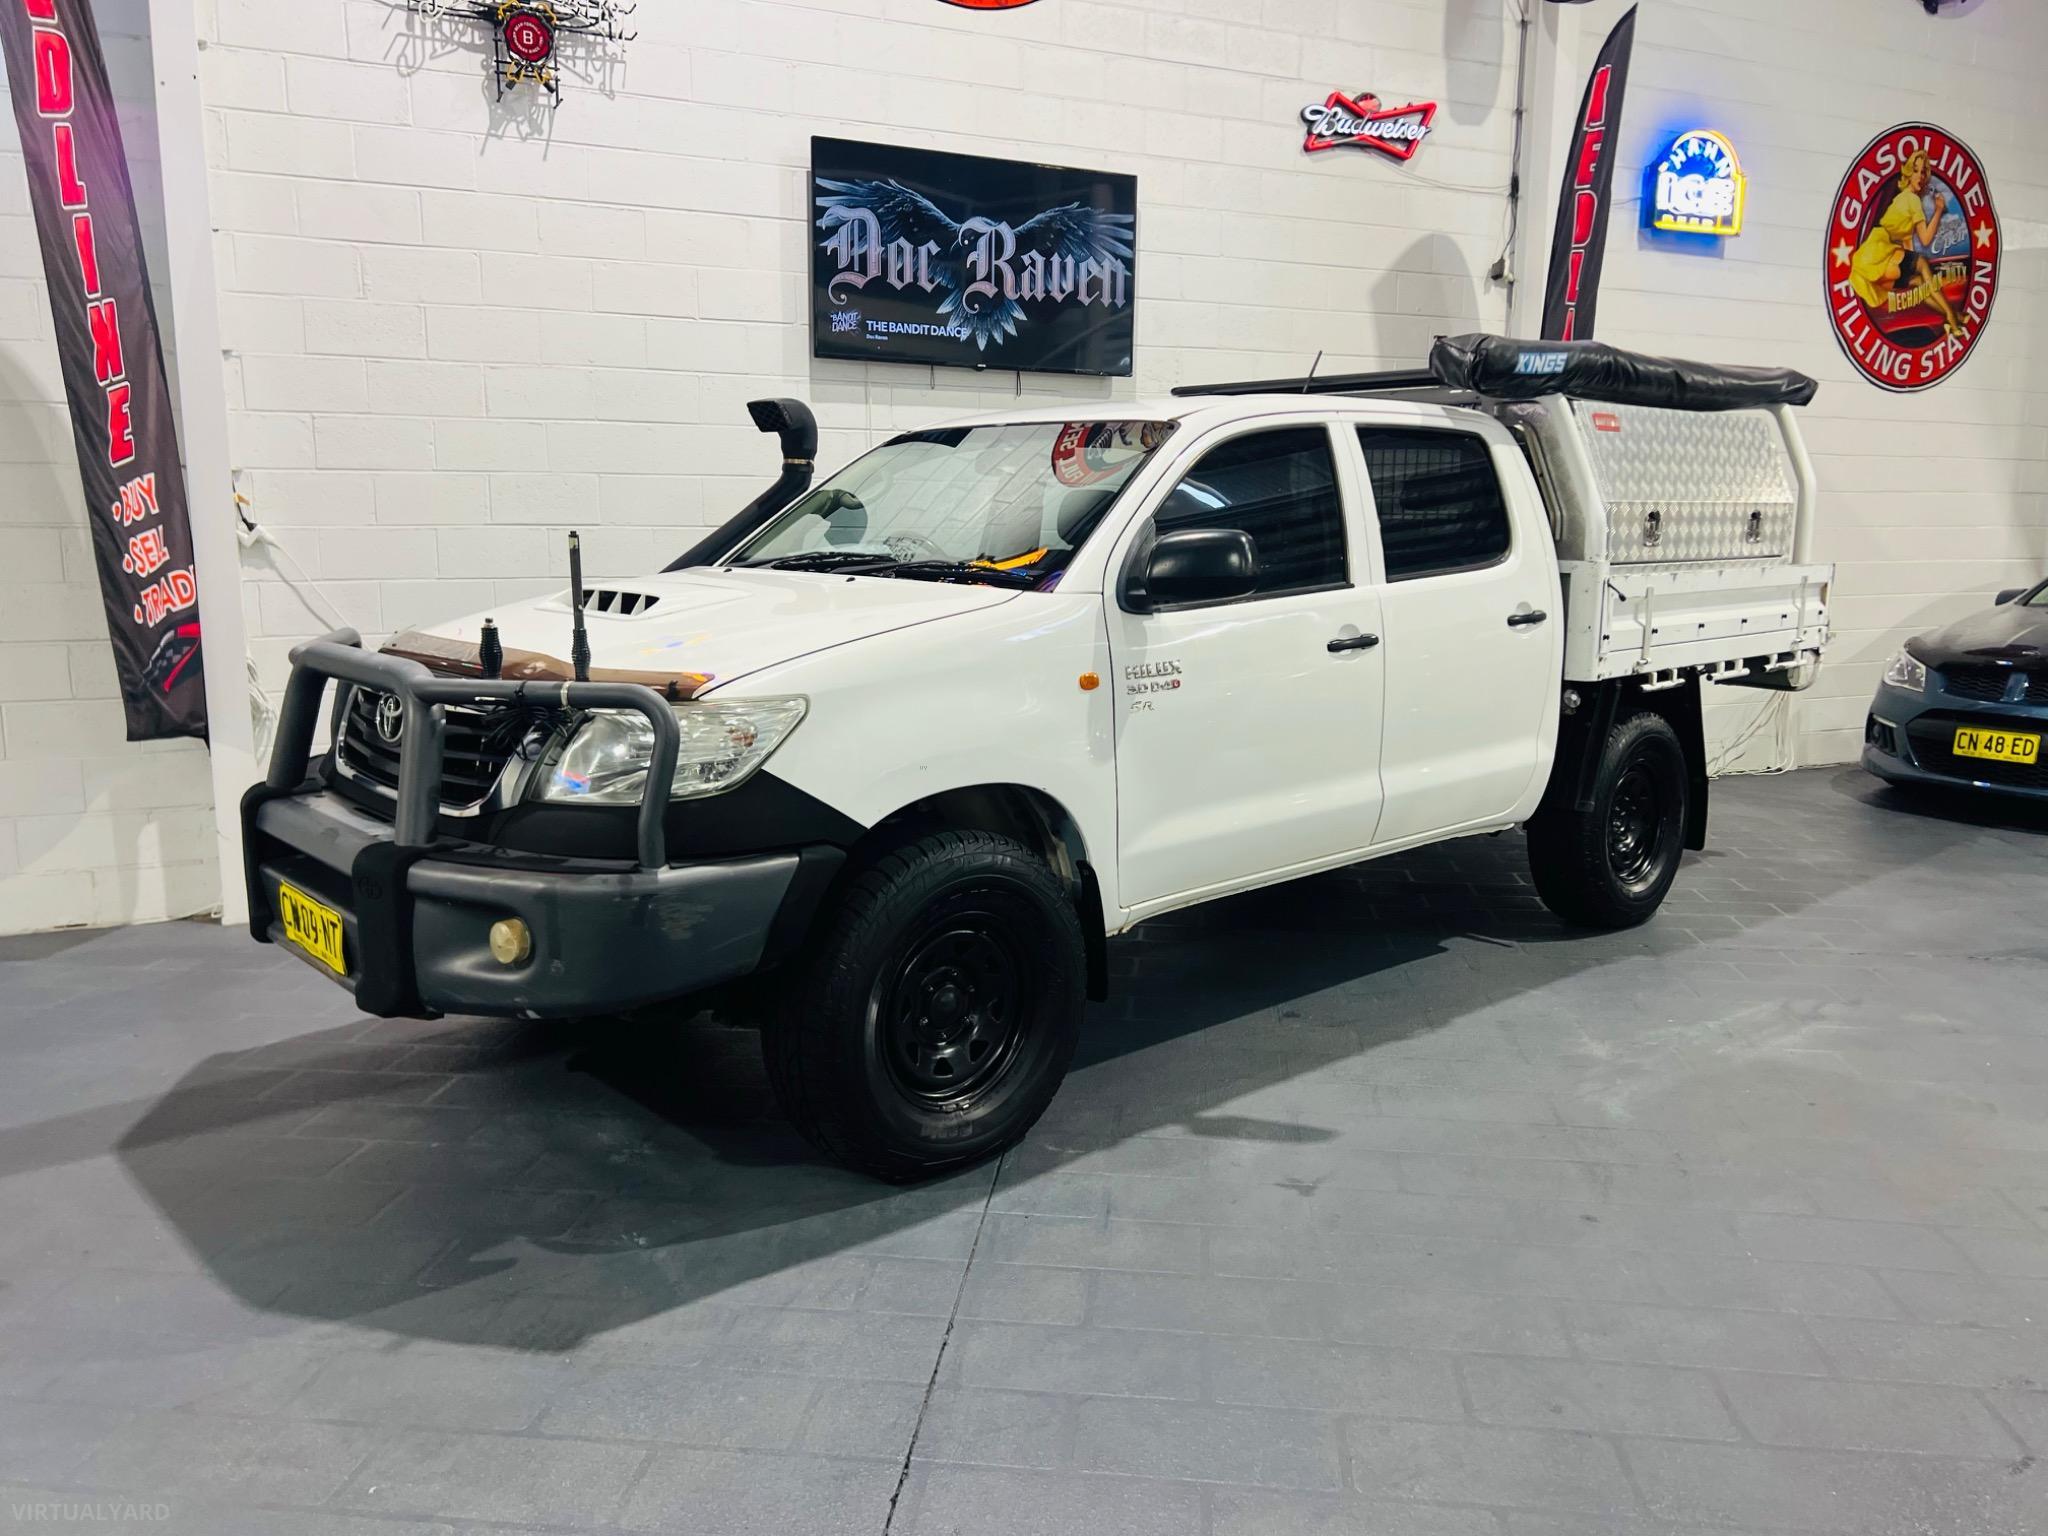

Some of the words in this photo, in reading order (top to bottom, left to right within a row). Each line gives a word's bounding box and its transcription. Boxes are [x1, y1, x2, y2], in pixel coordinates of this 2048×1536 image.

[523, 30, 533, 44] B
[1302, 104, 1429, 141] Budweiser
[1839, 134, 1985, 230] GASOLINE
[25, 0, 135, 468] DLINE
[822, 205, 941, 305] Doc
[958, 216, 1128, 314] Raven
[832, 320, 858, 332] DANCE
[866, 320, 888, 332] THE
[889, 322, 930, 335] BANDIT
[930, 325, 967, 338] DANCE
[1833, 280, 1911, 380] FILLING
[1919, 259, 1992, 378] STATION
[1513, 352, 1568, 375] KINGS
[119, 472, 160, 527] BUY
[140, 564, 197, 628] TRAD
[1957, 732, 1979, 751] CN
[1983, 735, 2005, 753] 48
[2010, 737, 2035, 756] ED
